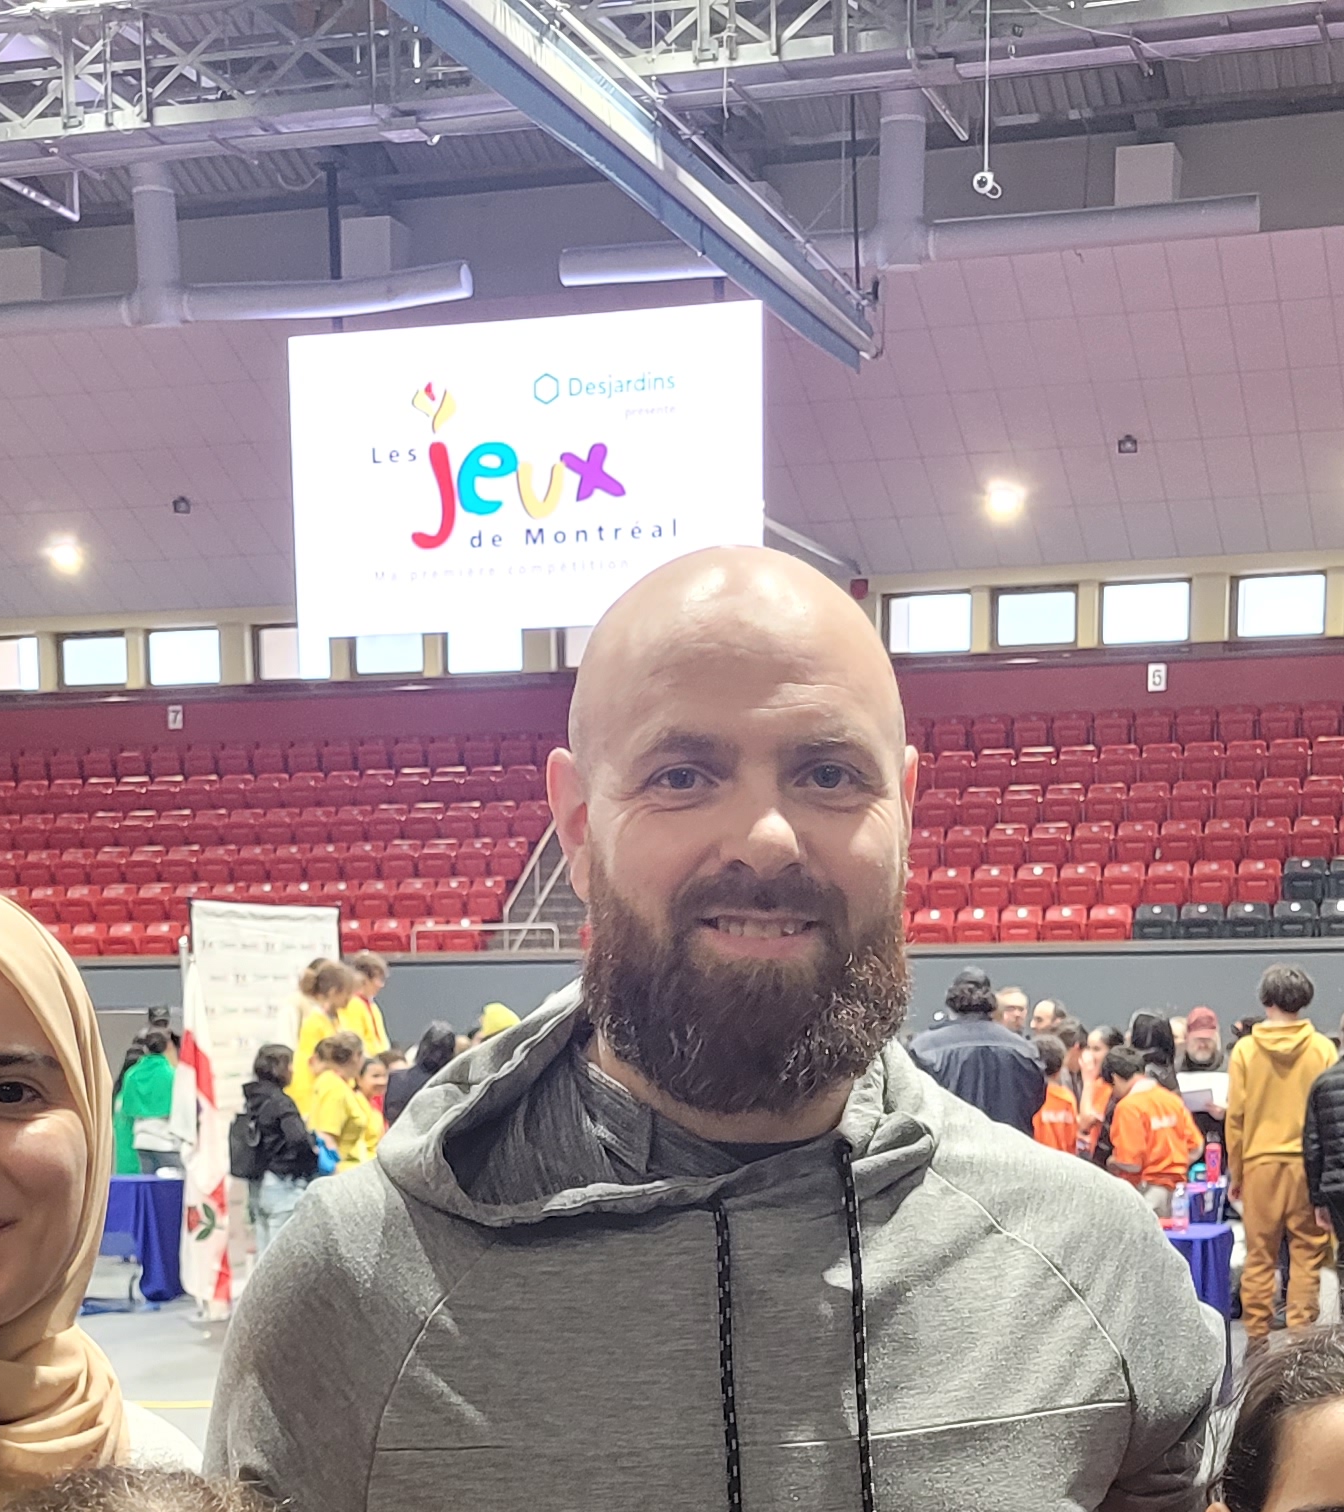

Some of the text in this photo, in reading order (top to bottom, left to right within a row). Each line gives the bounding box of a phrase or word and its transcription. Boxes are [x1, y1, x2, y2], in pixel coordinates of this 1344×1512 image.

[568, 373, 676, 398] Desjardins
[371, 441, 626, 550] Les jeux
[469, 518, 678, 549] de Montréal
[1152, 669, 1162, 687] 5
[171, 710, 181, 725] 7
